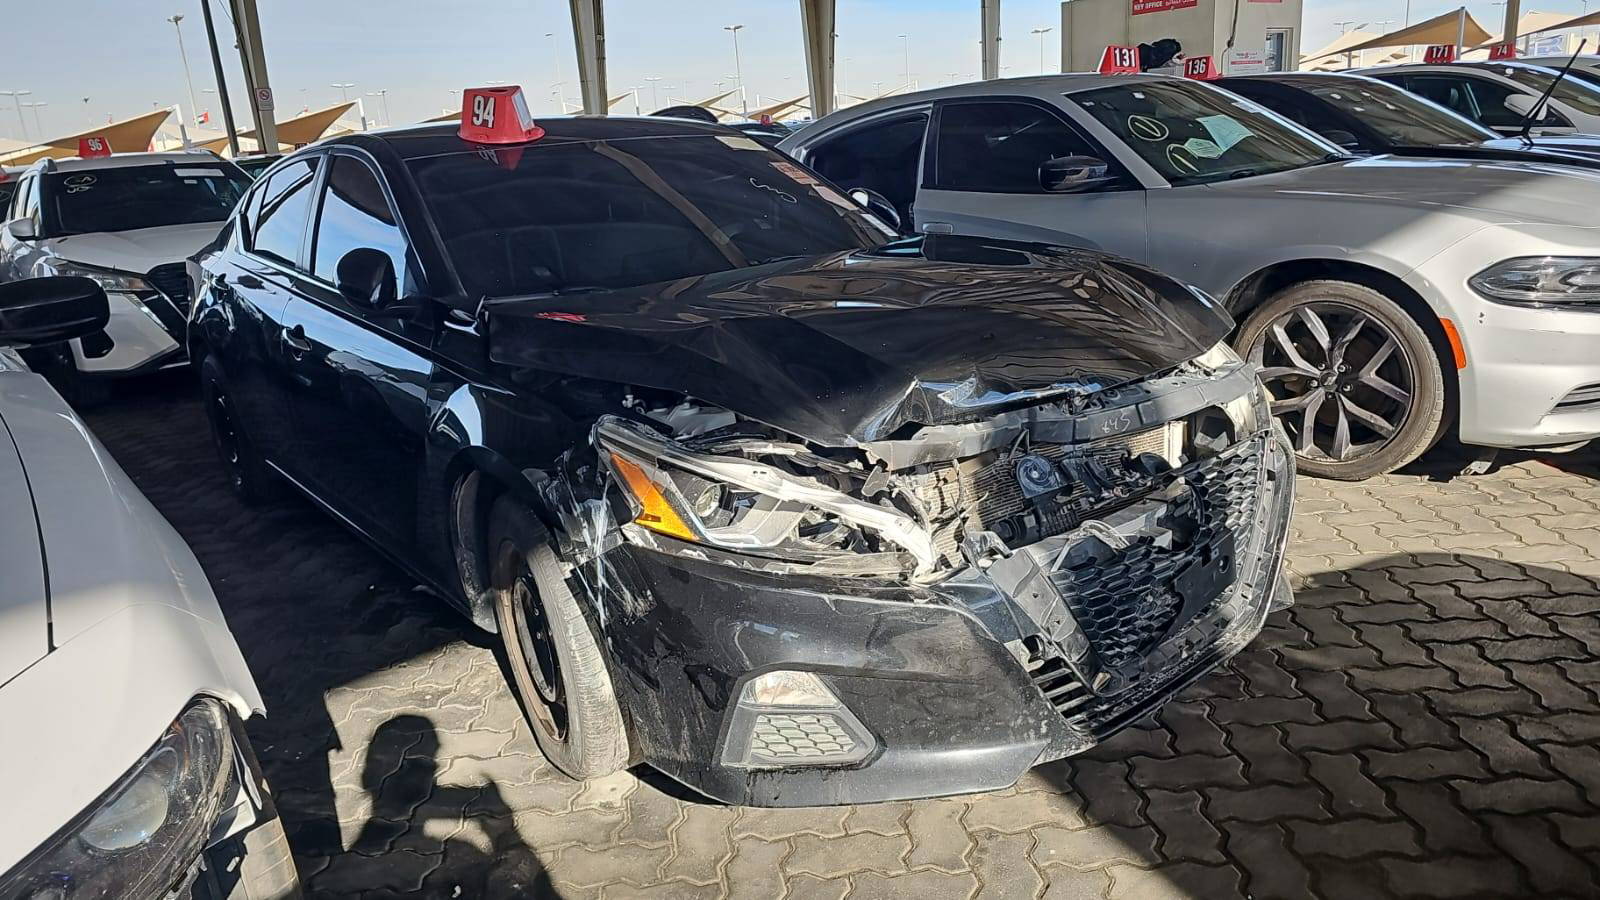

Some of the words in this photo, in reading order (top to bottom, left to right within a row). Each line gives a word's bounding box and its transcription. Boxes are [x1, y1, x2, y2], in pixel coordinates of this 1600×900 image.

[1432, 45, 1449, 58] 171
[1496, 44, 1508, 56] 74
[1114, 48, 1136, 67] 131
[1188, 59, 1207, 75] 136
[472, 95, 495, 128] 94
[87, 138, 103, 151] 96
